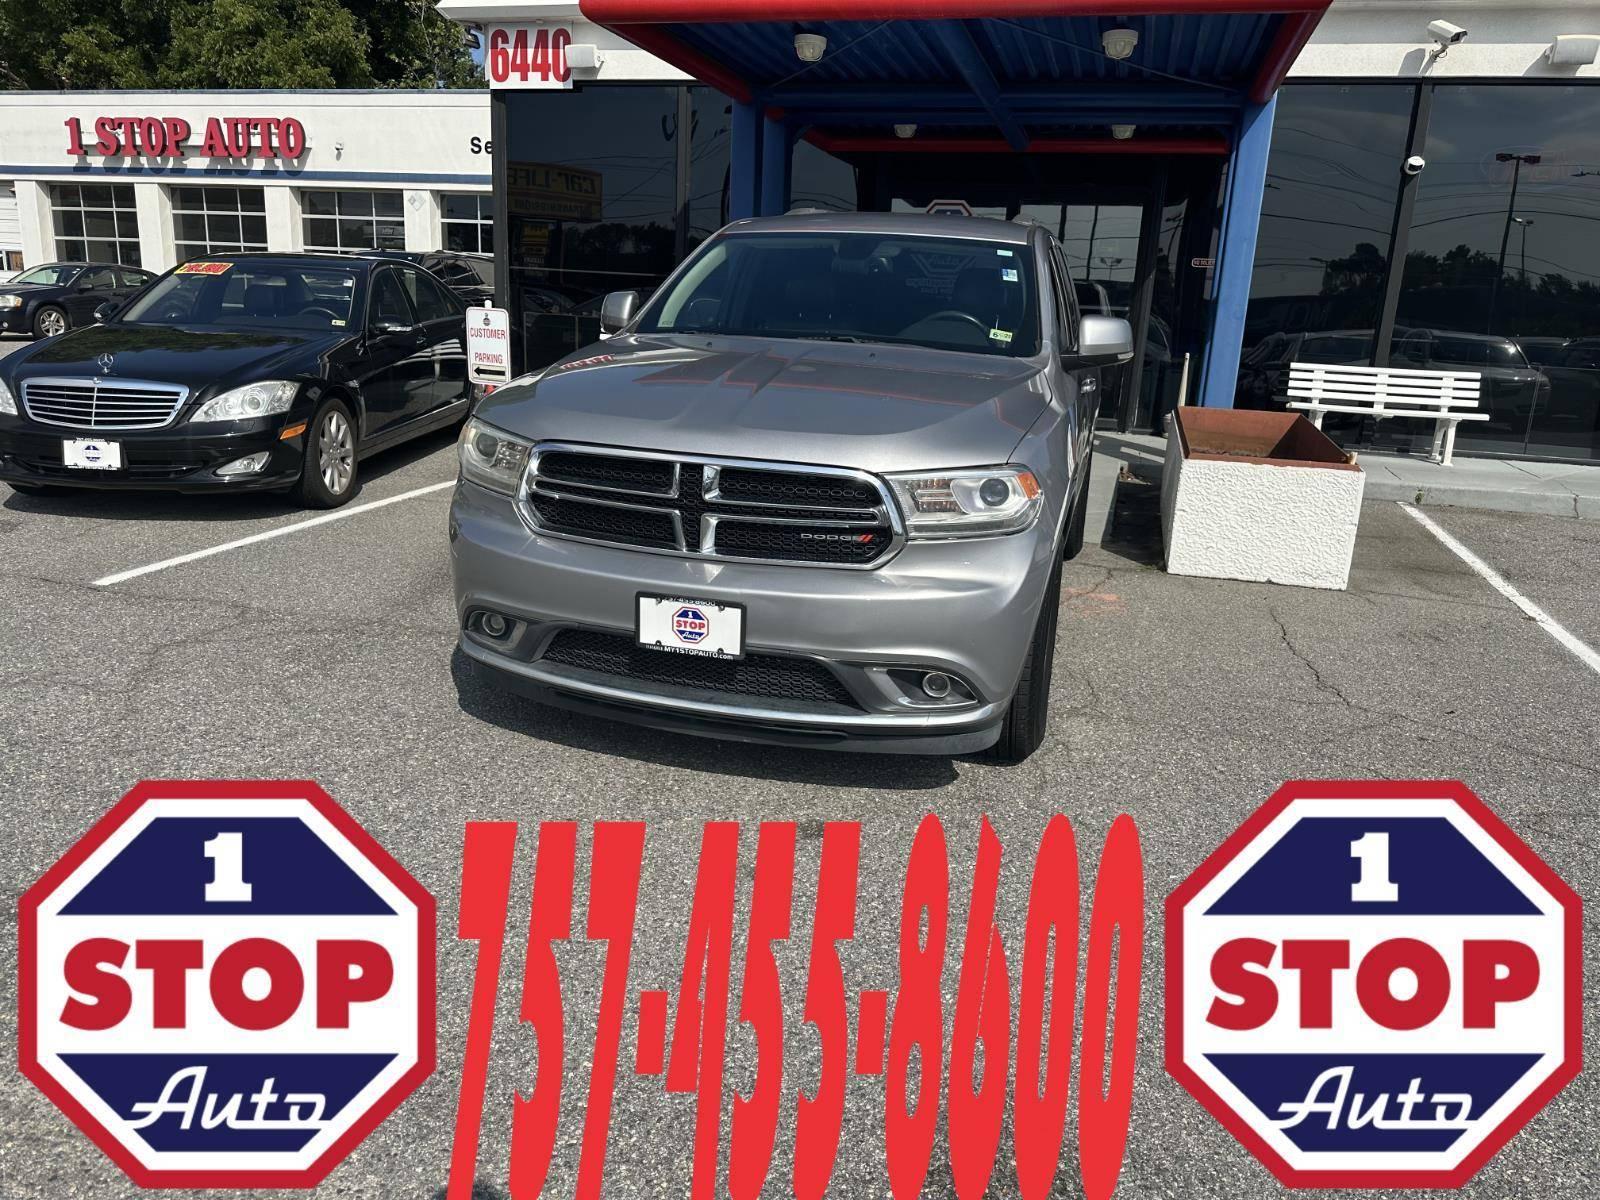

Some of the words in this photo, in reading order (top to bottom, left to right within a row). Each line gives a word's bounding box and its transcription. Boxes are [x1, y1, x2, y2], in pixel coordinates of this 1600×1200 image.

[490, 27, 572, 83] 6440
[64, 116, 88, 156] 1
[94, 116, 192, 158] STOP
[199, 116, 307, 160] AUTO
[469, 327, 506, 341] CUSTOMER
[474, 352, 503, 365] PARKING
[800, 533, 860, 542] DODGE
[687, 611, 694, 619] 1
[675, 619, 706, 631] STOP
[681, 631, 701, 640] Auto
[664, 645, 734, 661] MY1STOPAUTO.com
